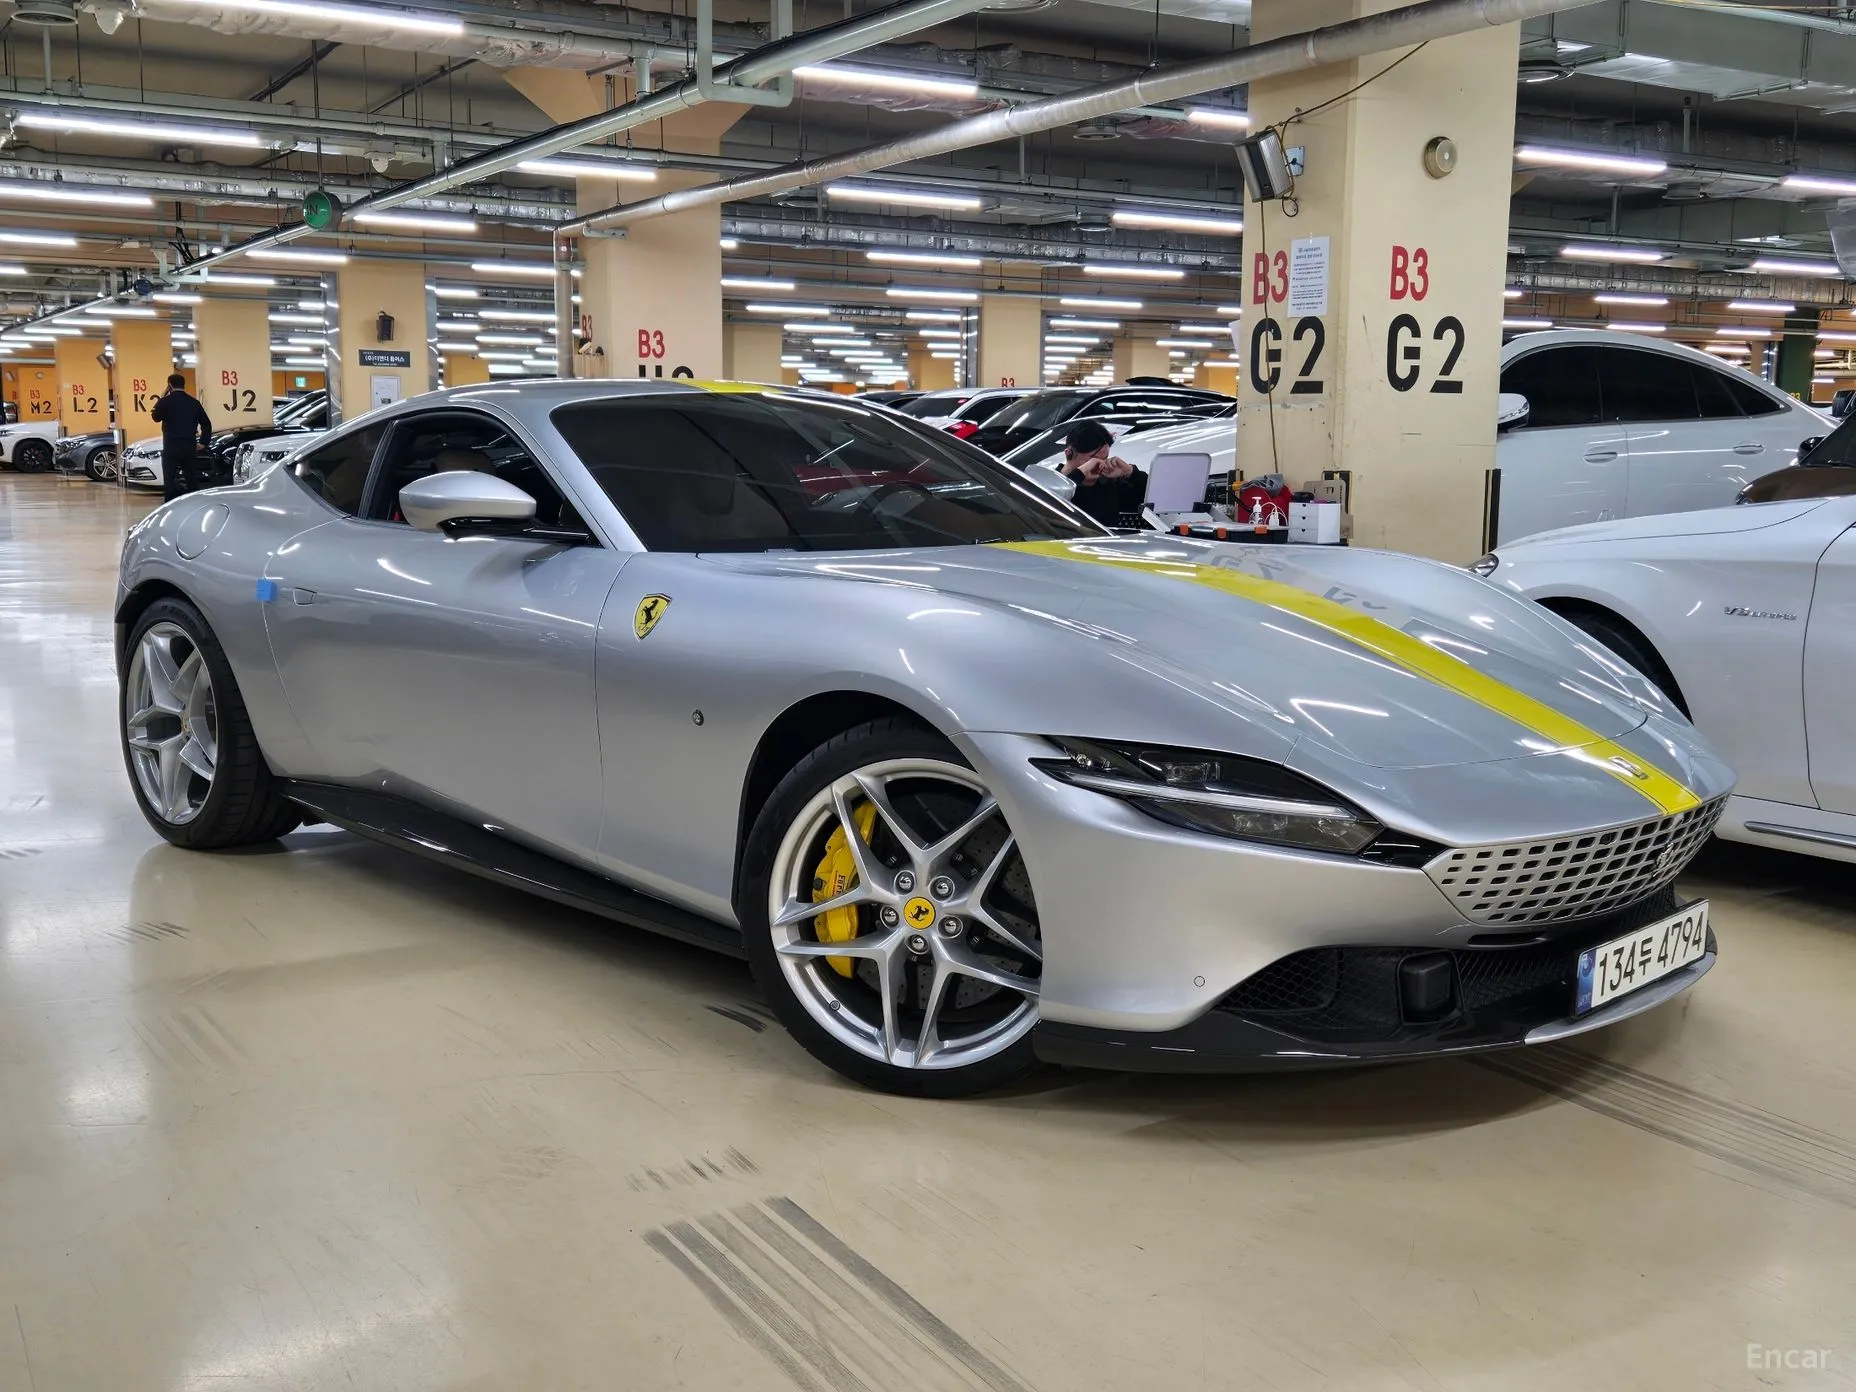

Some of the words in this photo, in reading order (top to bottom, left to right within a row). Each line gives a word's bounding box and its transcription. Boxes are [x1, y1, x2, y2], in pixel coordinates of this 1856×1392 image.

[1253, 250, 1288, 304] B3
[1390, 245, 1429, 301] B3
[639, 329, 665, 358] B3
[1250, 316, 1325, 394] G2
[1386, 313, 1465, 394] G2
[72, 384, 85, 395] B3
[133, 379, 147, 391] B3
[221, 370, 238, 386] B3
[30, 389, 40, 399] B3
[73, 397, 98, 413] L2
[223, 389, 257, 413] J2
[31, 400, 52, 414] M2
[1599, 936, 1653, 996] 134두
[1657, 911, 1704, 968] 4794
